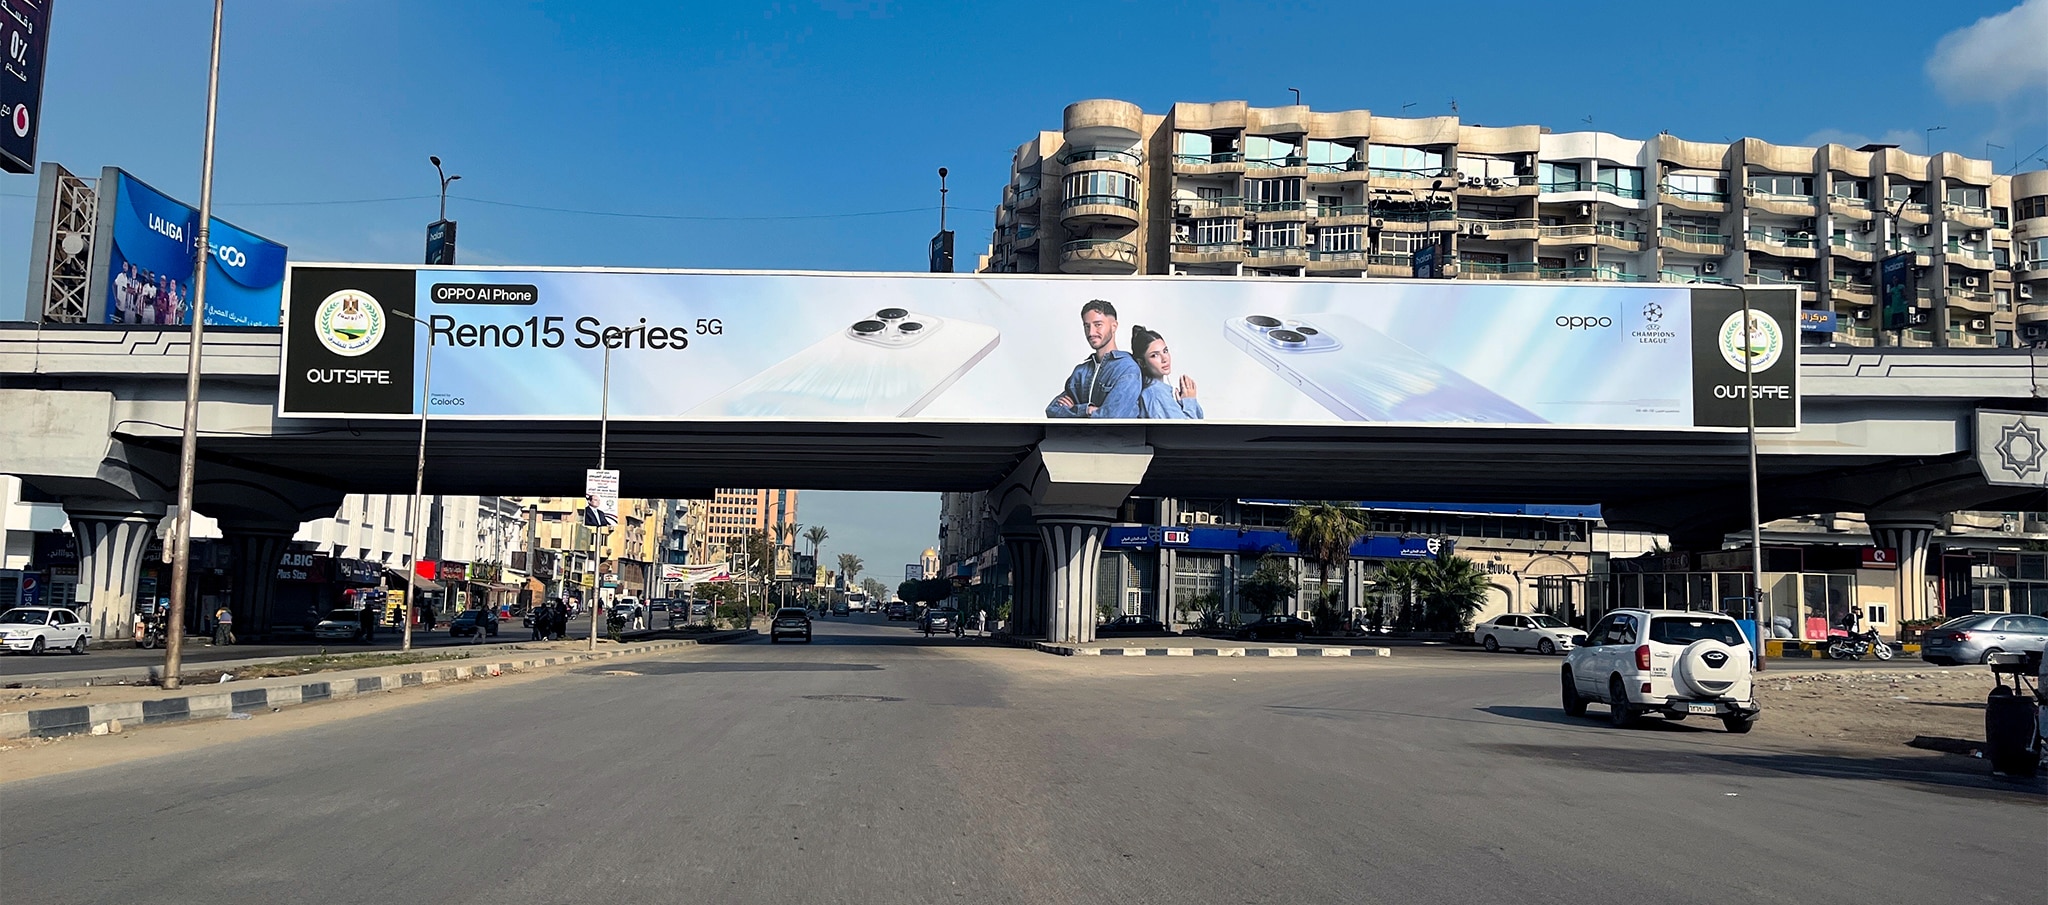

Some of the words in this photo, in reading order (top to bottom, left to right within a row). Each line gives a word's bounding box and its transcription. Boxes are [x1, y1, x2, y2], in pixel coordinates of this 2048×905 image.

[149, 213, 183, 243] LALIGA
[437, 287, 476, 300] OPPO
[477, 288, 491, 300] AI
[493, 288, 532, 301] Phone
[1555, 315, 1612, 330] oppo
[429, 314, 565, 349] Reno15
[574, 316, 689, 350] Series
[695, 318, 723, 335] 5G
[430, 397, 465, 406] ColorOS
[280, 553, 313, 566] R.BIG
